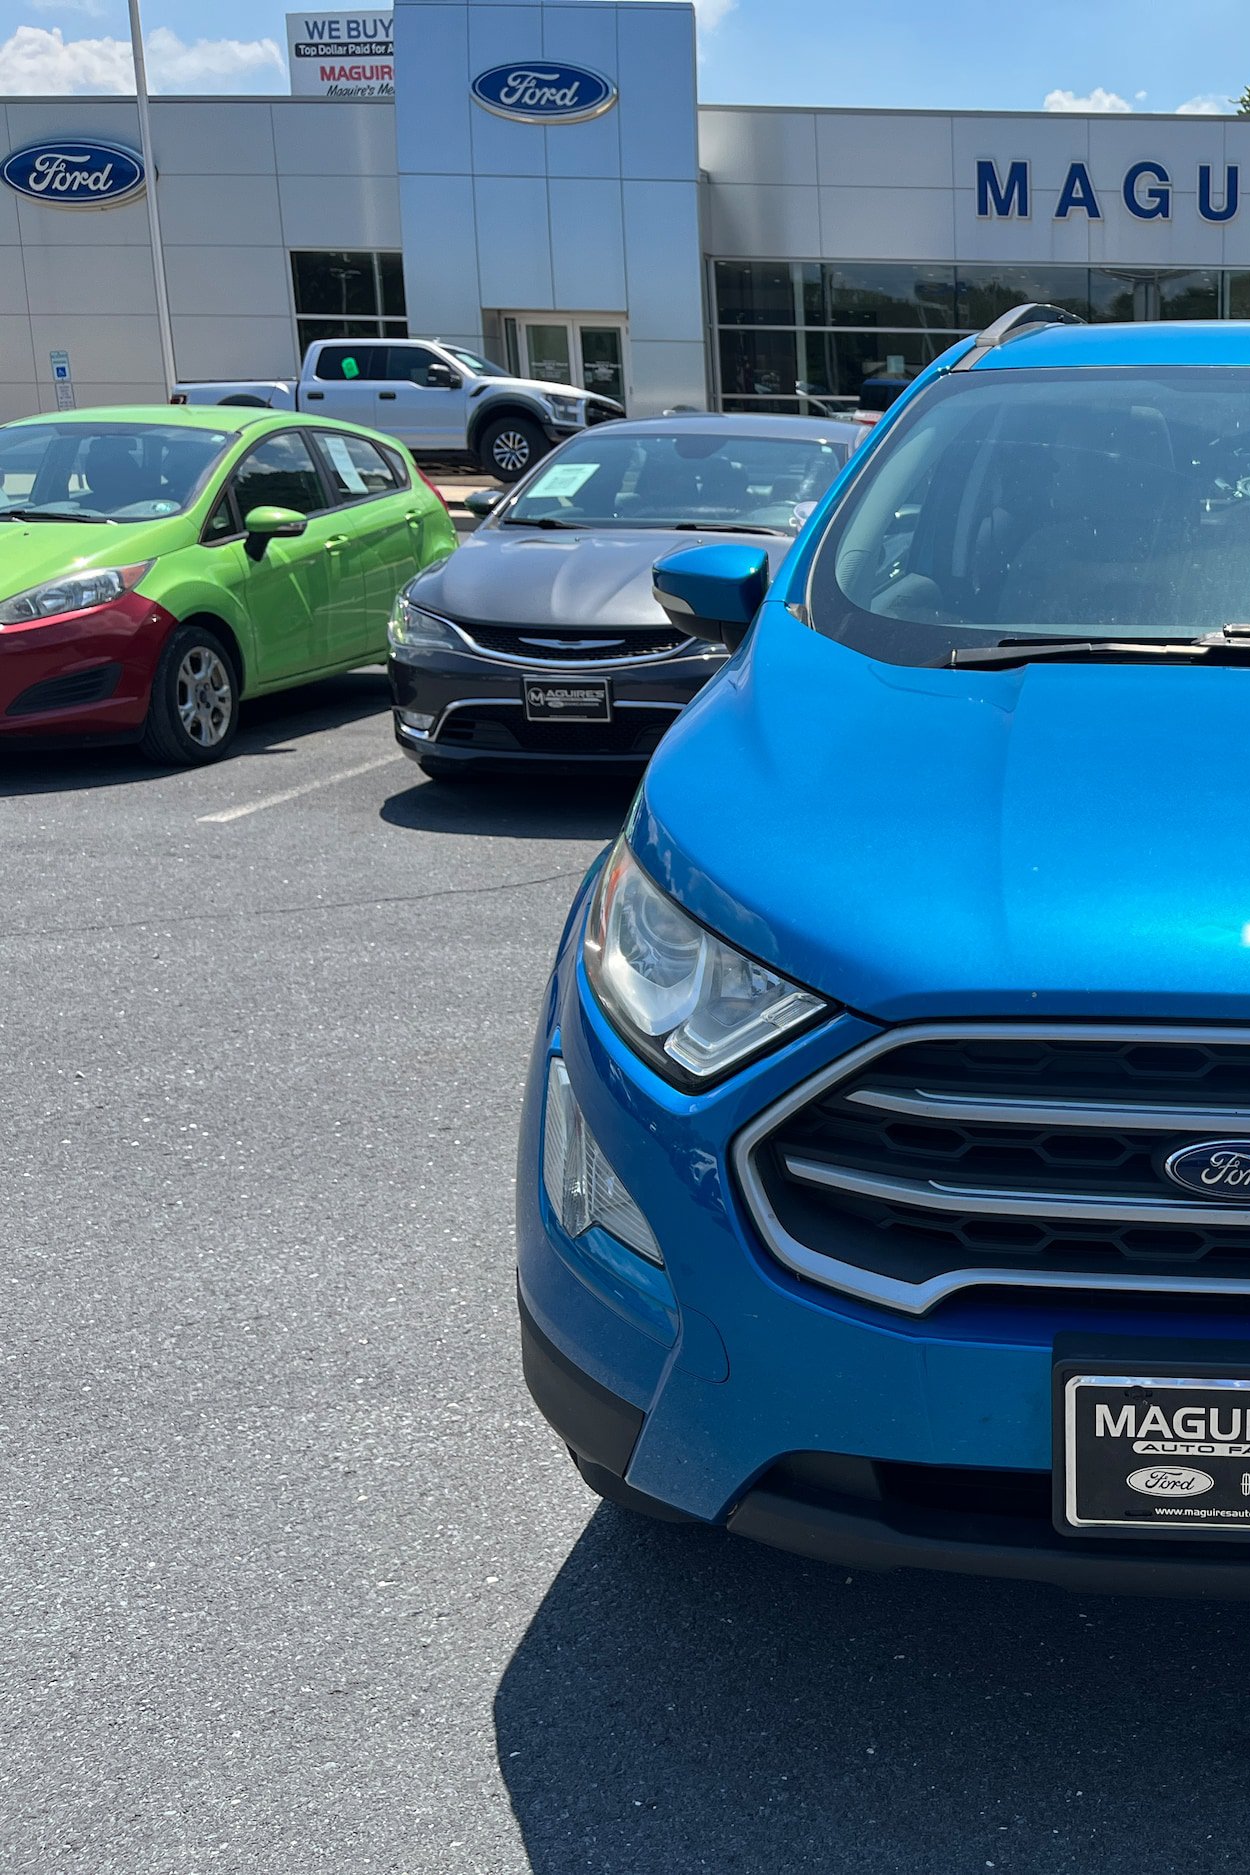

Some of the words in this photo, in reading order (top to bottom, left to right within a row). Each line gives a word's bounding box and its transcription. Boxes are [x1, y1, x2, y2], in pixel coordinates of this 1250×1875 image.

[304, 20, 341, 40] WE
[347, 18, 394, 39] BUY
[298, 44, 317, 56] Top
[318, 44, 348, 56] Dollar
[348, 43, 371, 55] Paid
[371, 43, 386, 54] for
[320, 64, 395, 81] MAGUIR
[500, 71, 580, 106] Ford
[29, 153, 114, 191] Ford
[1141, 1443, 1215, 1454] AUTO
[1145, 1470, 1195, 1491] Ford
